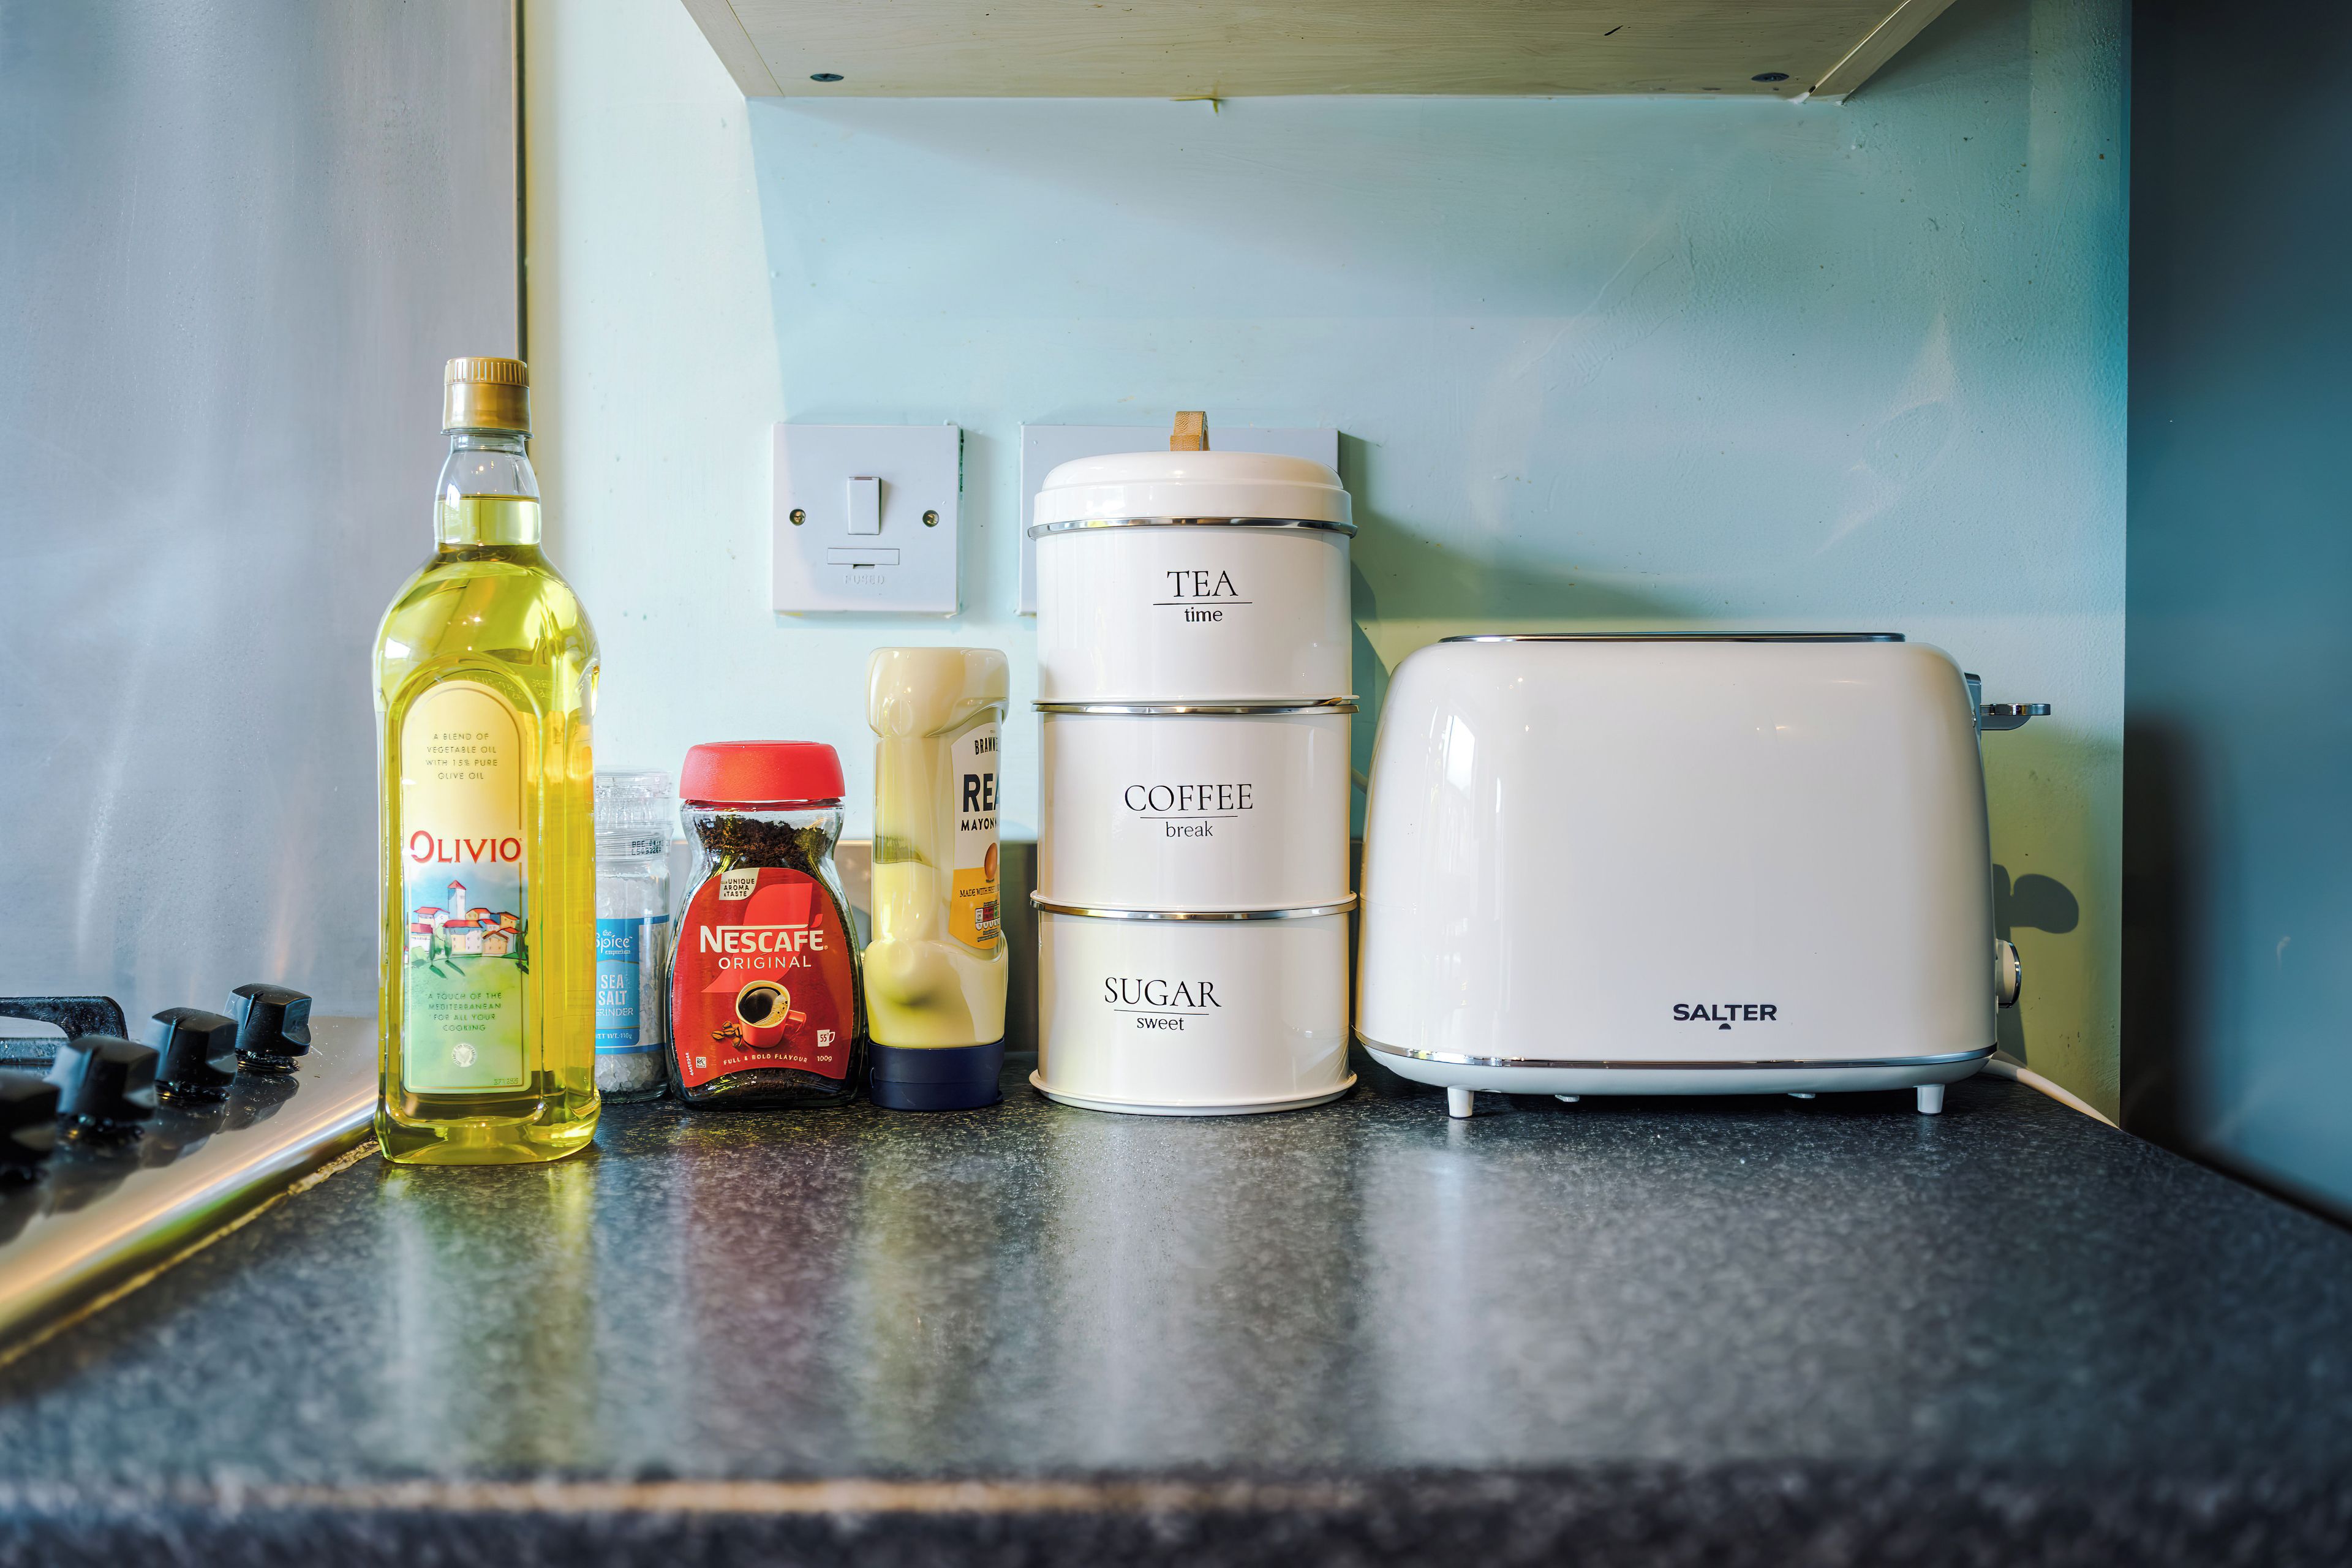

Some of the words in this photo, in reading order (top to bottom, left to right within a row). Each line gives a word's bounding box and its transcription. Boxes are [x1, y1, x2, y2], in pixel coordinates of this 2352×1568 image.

[1167, 570, 1238, 597] TEA
[1185, 607, 1223, 622] time
[1125, 784, 1253, 812] COFFEE
[1166, 821, 1213, 837] break
[410, 830, 521, 864] OLIVIO
[718, 956, 811, 970] ORIGINAL
[600, 974, 624, 989] SEA
[598, 990, 627, 1006] SALT
[1105, 977, 1222, 1008] SUGAR
[1673, 1004, 1777, 1021] SALTER
[1137, 1017, 1185, 1031] sweet
[774, 1054, 808, 1063] FLAVOUR
